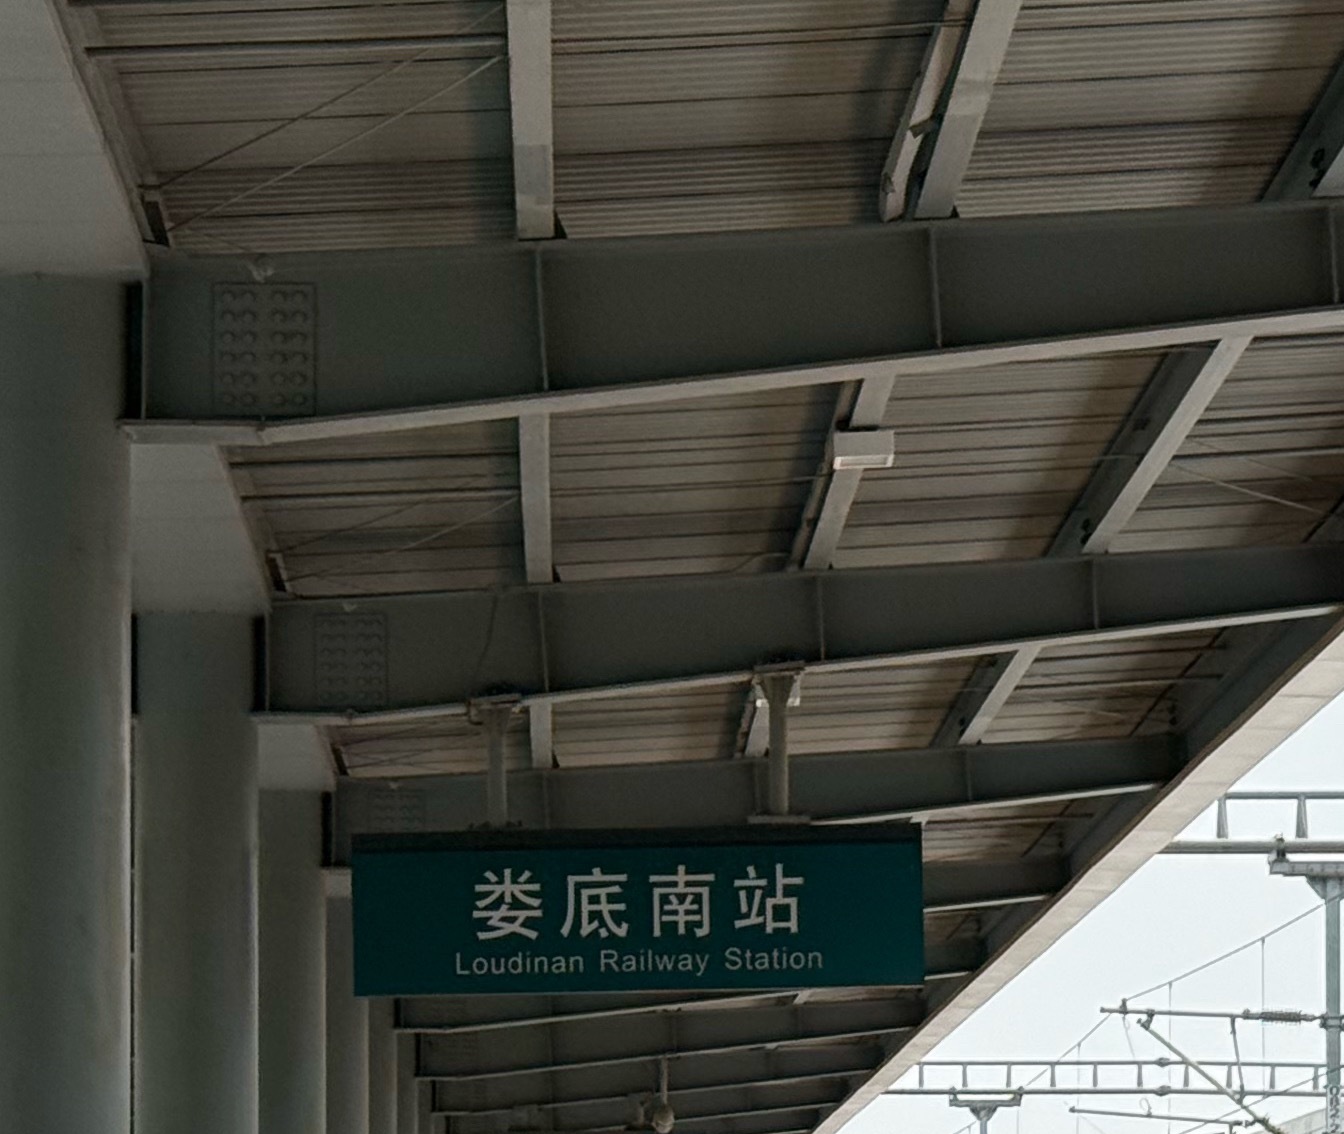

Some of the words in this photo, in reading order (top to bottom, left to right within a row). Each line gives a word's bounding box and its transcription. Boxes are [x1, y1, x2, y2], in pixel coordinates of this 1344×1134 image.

[471, 863, 805, 941] 娄底南站
[455, 950, 585, 976] Loudinan
[599, 948, 709, 977] Railway
[723, 946, 824, 971] Station
